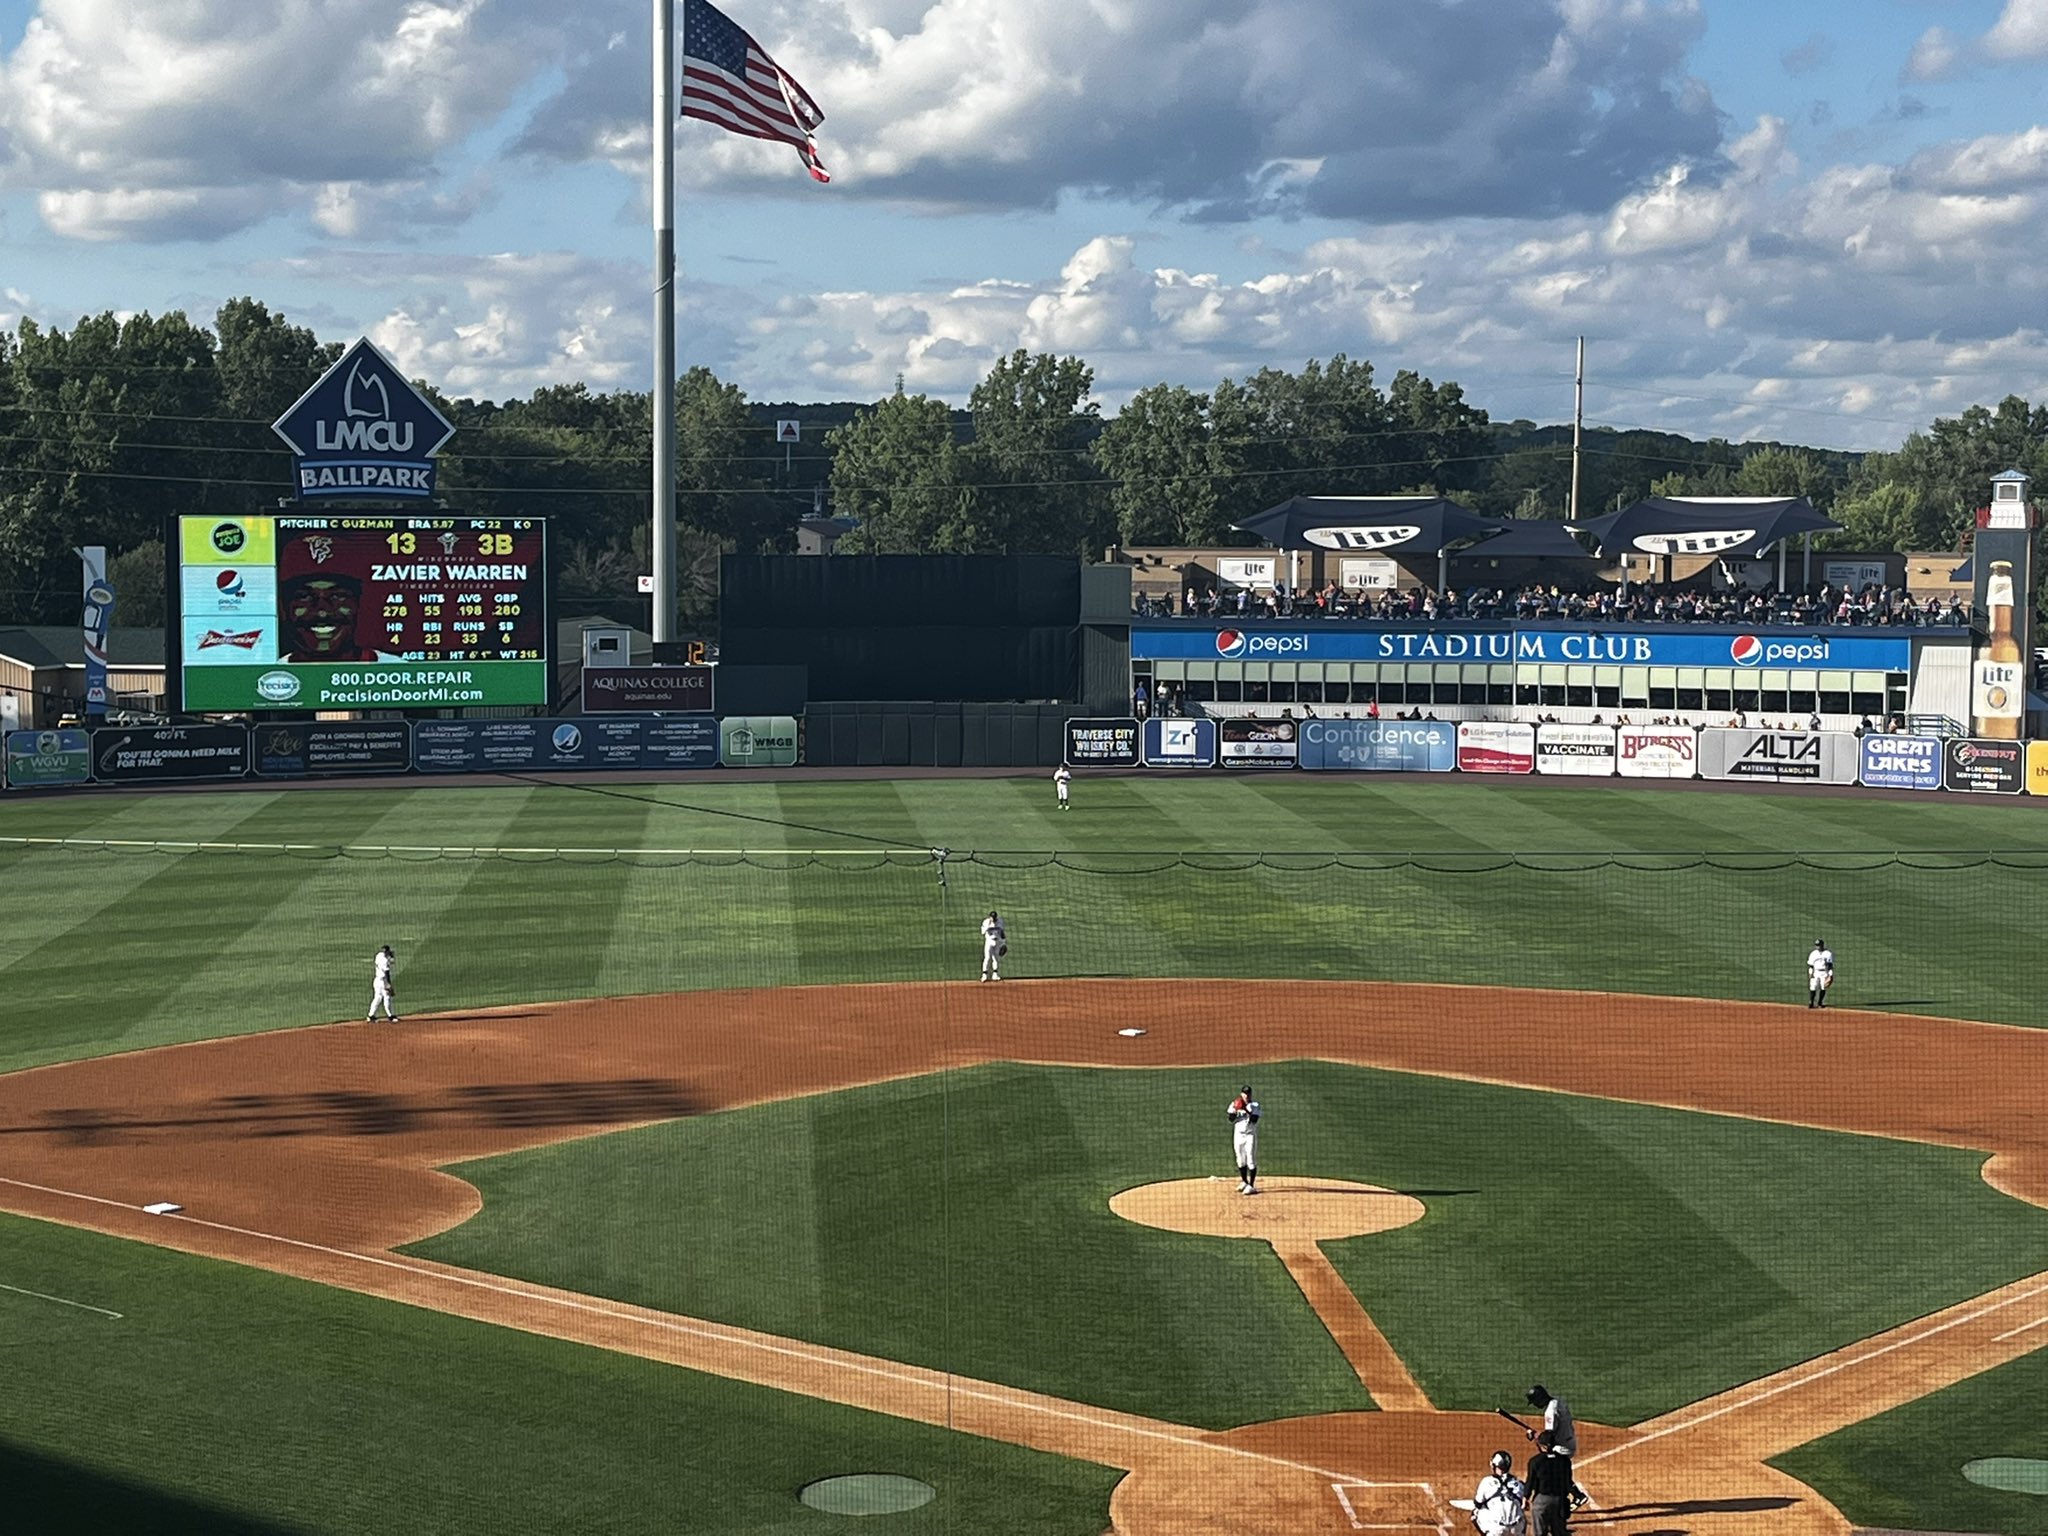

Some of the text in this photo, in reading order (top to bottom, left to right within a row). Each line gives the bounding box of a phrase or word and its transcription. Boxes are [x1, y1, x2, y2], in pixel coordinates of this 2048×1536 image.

[316, 420, 414, 452] LMCU
[301, 468, 430, 488] BALLPARK
[280, 519, 394, 529] PITCHER C GUZMAN
[408, 520, 431, 530] ERA
[471, 520, 502, 530] PC 22
[514, 520, 522, 530] K
[219, 536, 241, 547] JOE
[386, 533, 417, 555] 13
[478, 534, 514, 556] 3B
[371, 565, 527, 581] ZAVIER WARREN
[386, 594, 404, 604] AB
[419, 594, 446, 604] HITS
[457, 594, 482, 605] AVG
[495, 594, 518, 605] OBP
[383, 605, 408, 617] 278
[424, 605, 441, 617] 55
[386, 622, 404, 633] HR
[422, 622, 442, 633] RBI
[453, 622, 485, 633] RUNS
[498, 622, 514, 633] SB
[390, 634, 400, 646] 4
[424, 634, 441, 646] 23
[461, 634, 478, 646] 33
[501, 634, 511, 646] 6
[1249, 635, 1308, 655] pepsi
[688, 642, 705, 665] 12
[1379, 633, 1651, 662] STADIUM CLUB
[1766, 642, 1830, 663] pepsi
[401, 651, 441, 661] AGE 23
[449, 650, 464, 660] HT
[499, 650, 518, 660] WT
[331, 671, 472, 686] 800.DOOR.REPAIR
[1982, 666, 2013, 685] Lite
[592, 676, 704, 691] AQUINAS COLLEGE
[320, 688, 483, 703] PrecisionDoorMI.com
[624, 692, 672, 702] aquinas.edu
[1072, 729, 1134, 741] TRAVERSE CITY
[1305, 722, 1448, 746] Confidence.
[754, 738, 794, 752] WMGB
[1076, 740, 1114, 752] WHISKEY
[1543, 745, 1609, 756] VACCINATE.
[1621, 735, 1692, 760] BURGESS
[1742, 734, 1821, 761] ALTA
[1867, 739, 1935, 756] GREAT
[153, 750, 190, 758] GONNA
[191, 748, 216, 757] NEED
[31, 756, 70, 768] WGVU
[117, 759, 136, 768] FOR
[1867, 756, 1933, 773] LAKES
[1740, 765, 1815, 775] MATERIAL HANDLING
